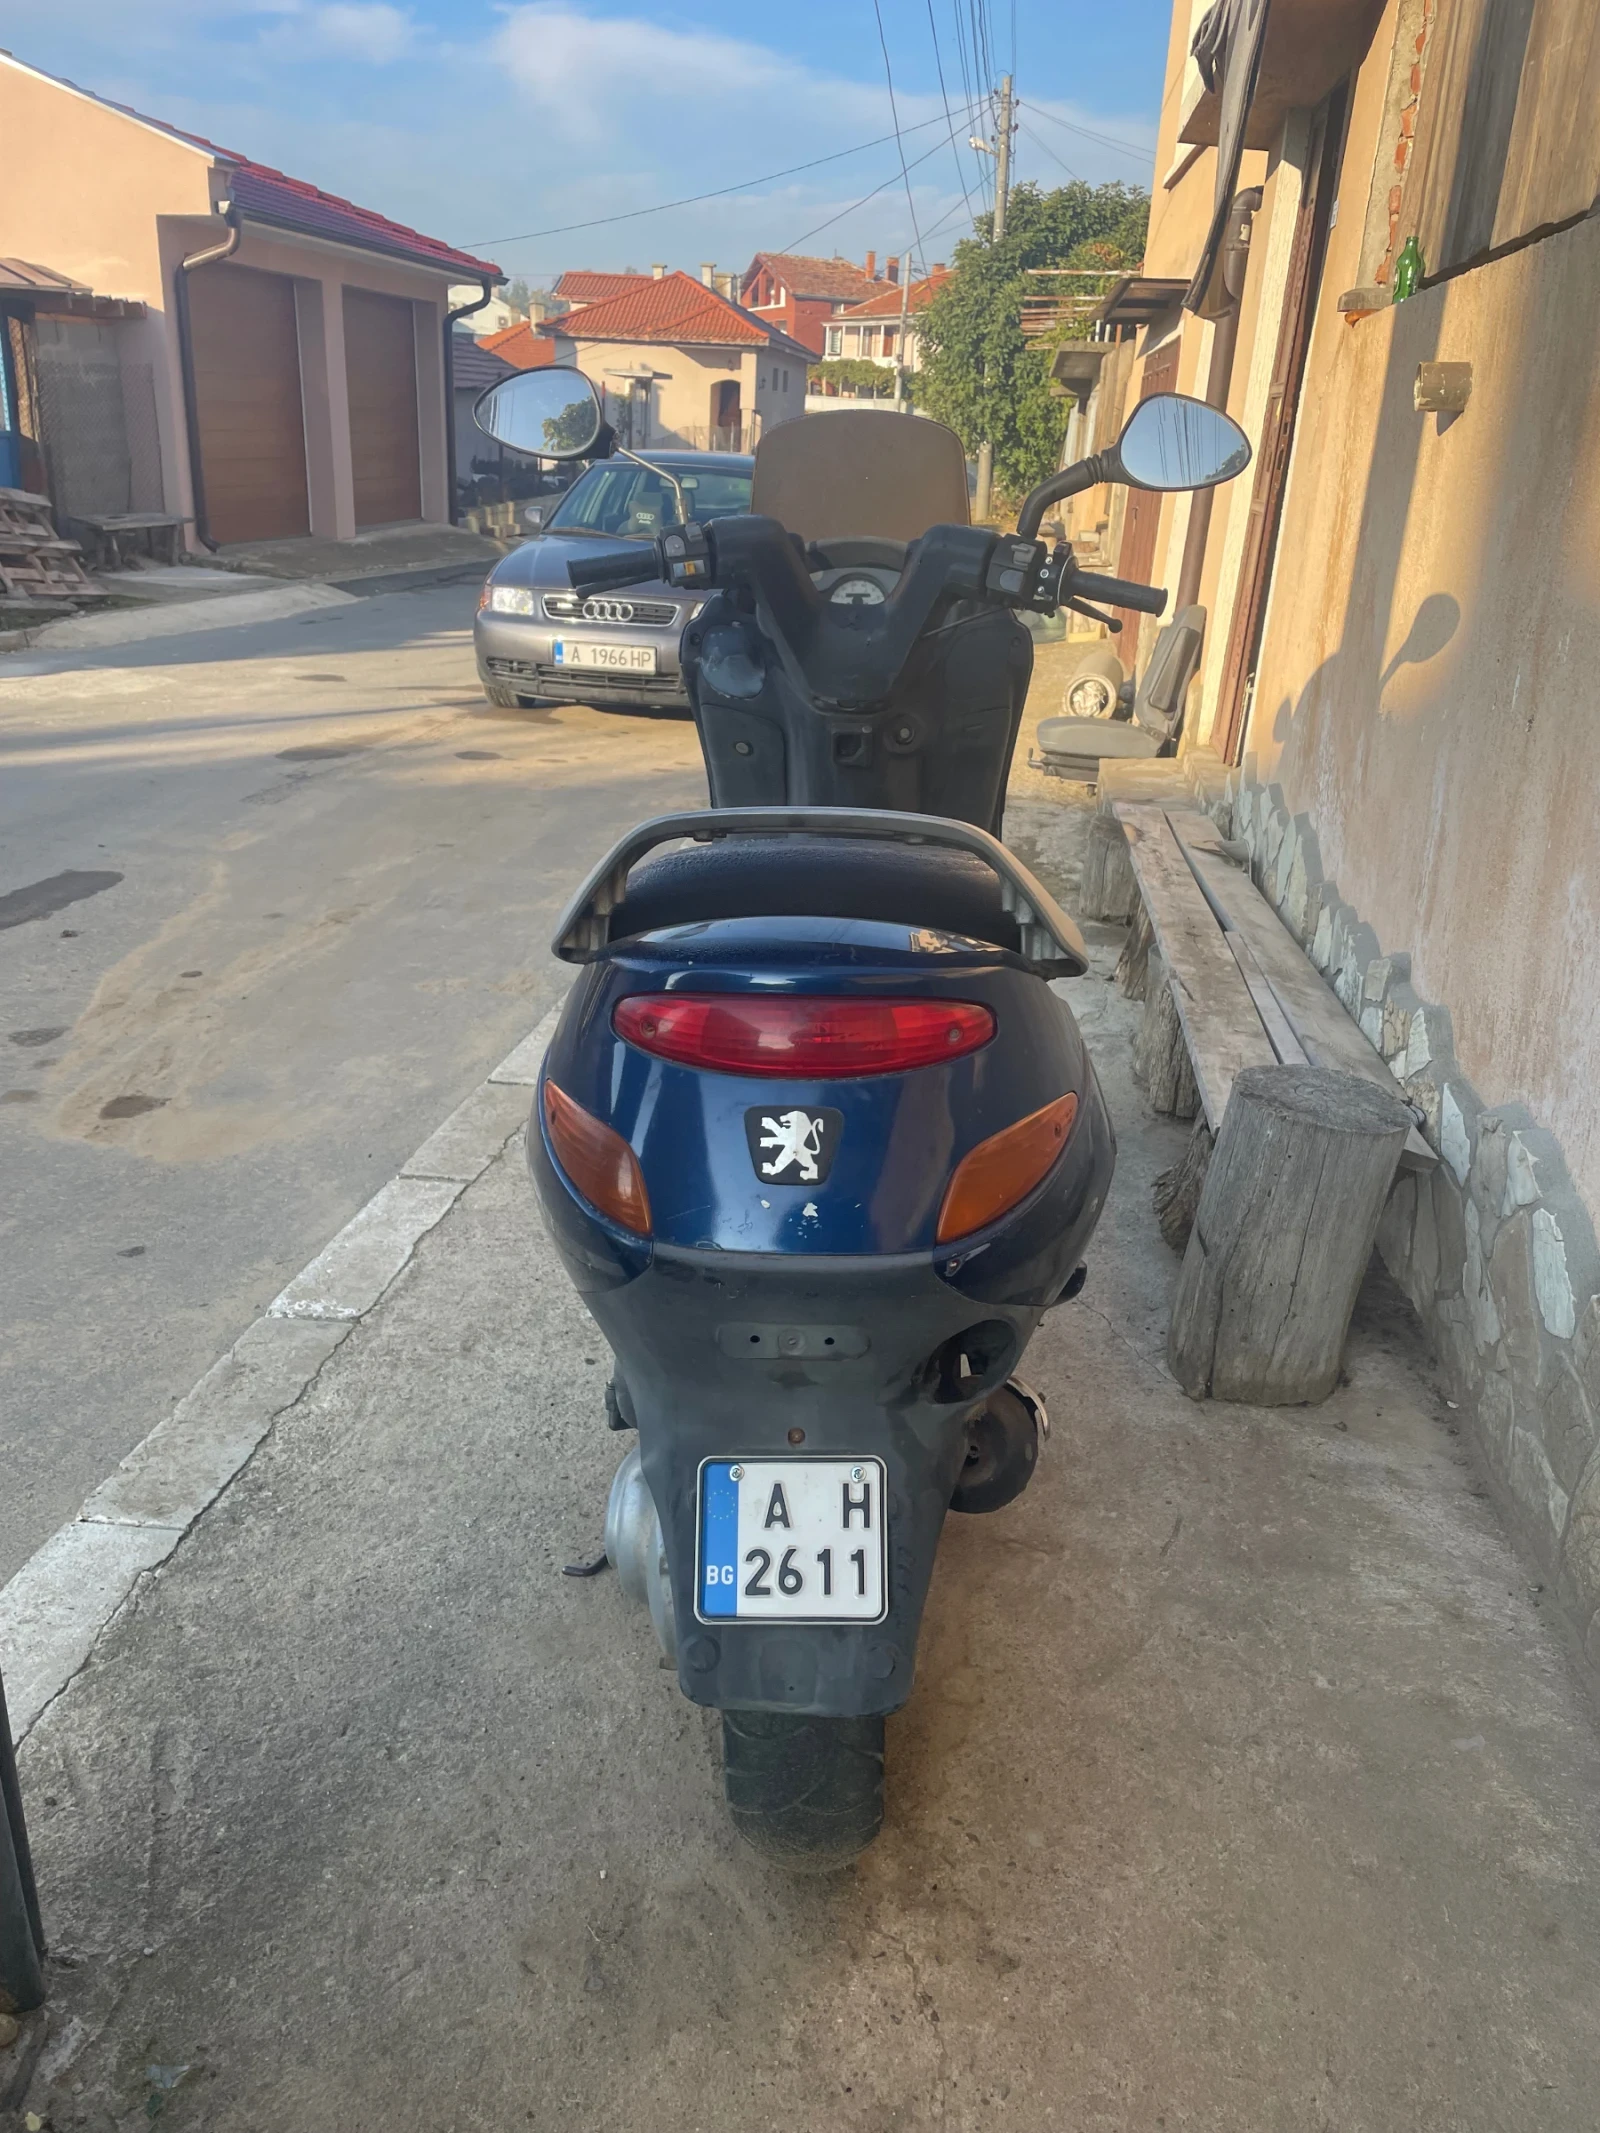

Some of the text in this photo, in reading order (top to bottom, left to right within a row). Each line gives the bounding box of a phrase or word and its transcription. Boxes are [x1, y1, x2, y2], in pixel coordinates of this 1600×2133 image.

[571, 646, 651, 668] A 1966 HP
[764, 1483, 871, 1529] A H
[706, 1564, 734, 1585] BG
[744, 1548, 865, 1596] 2611
